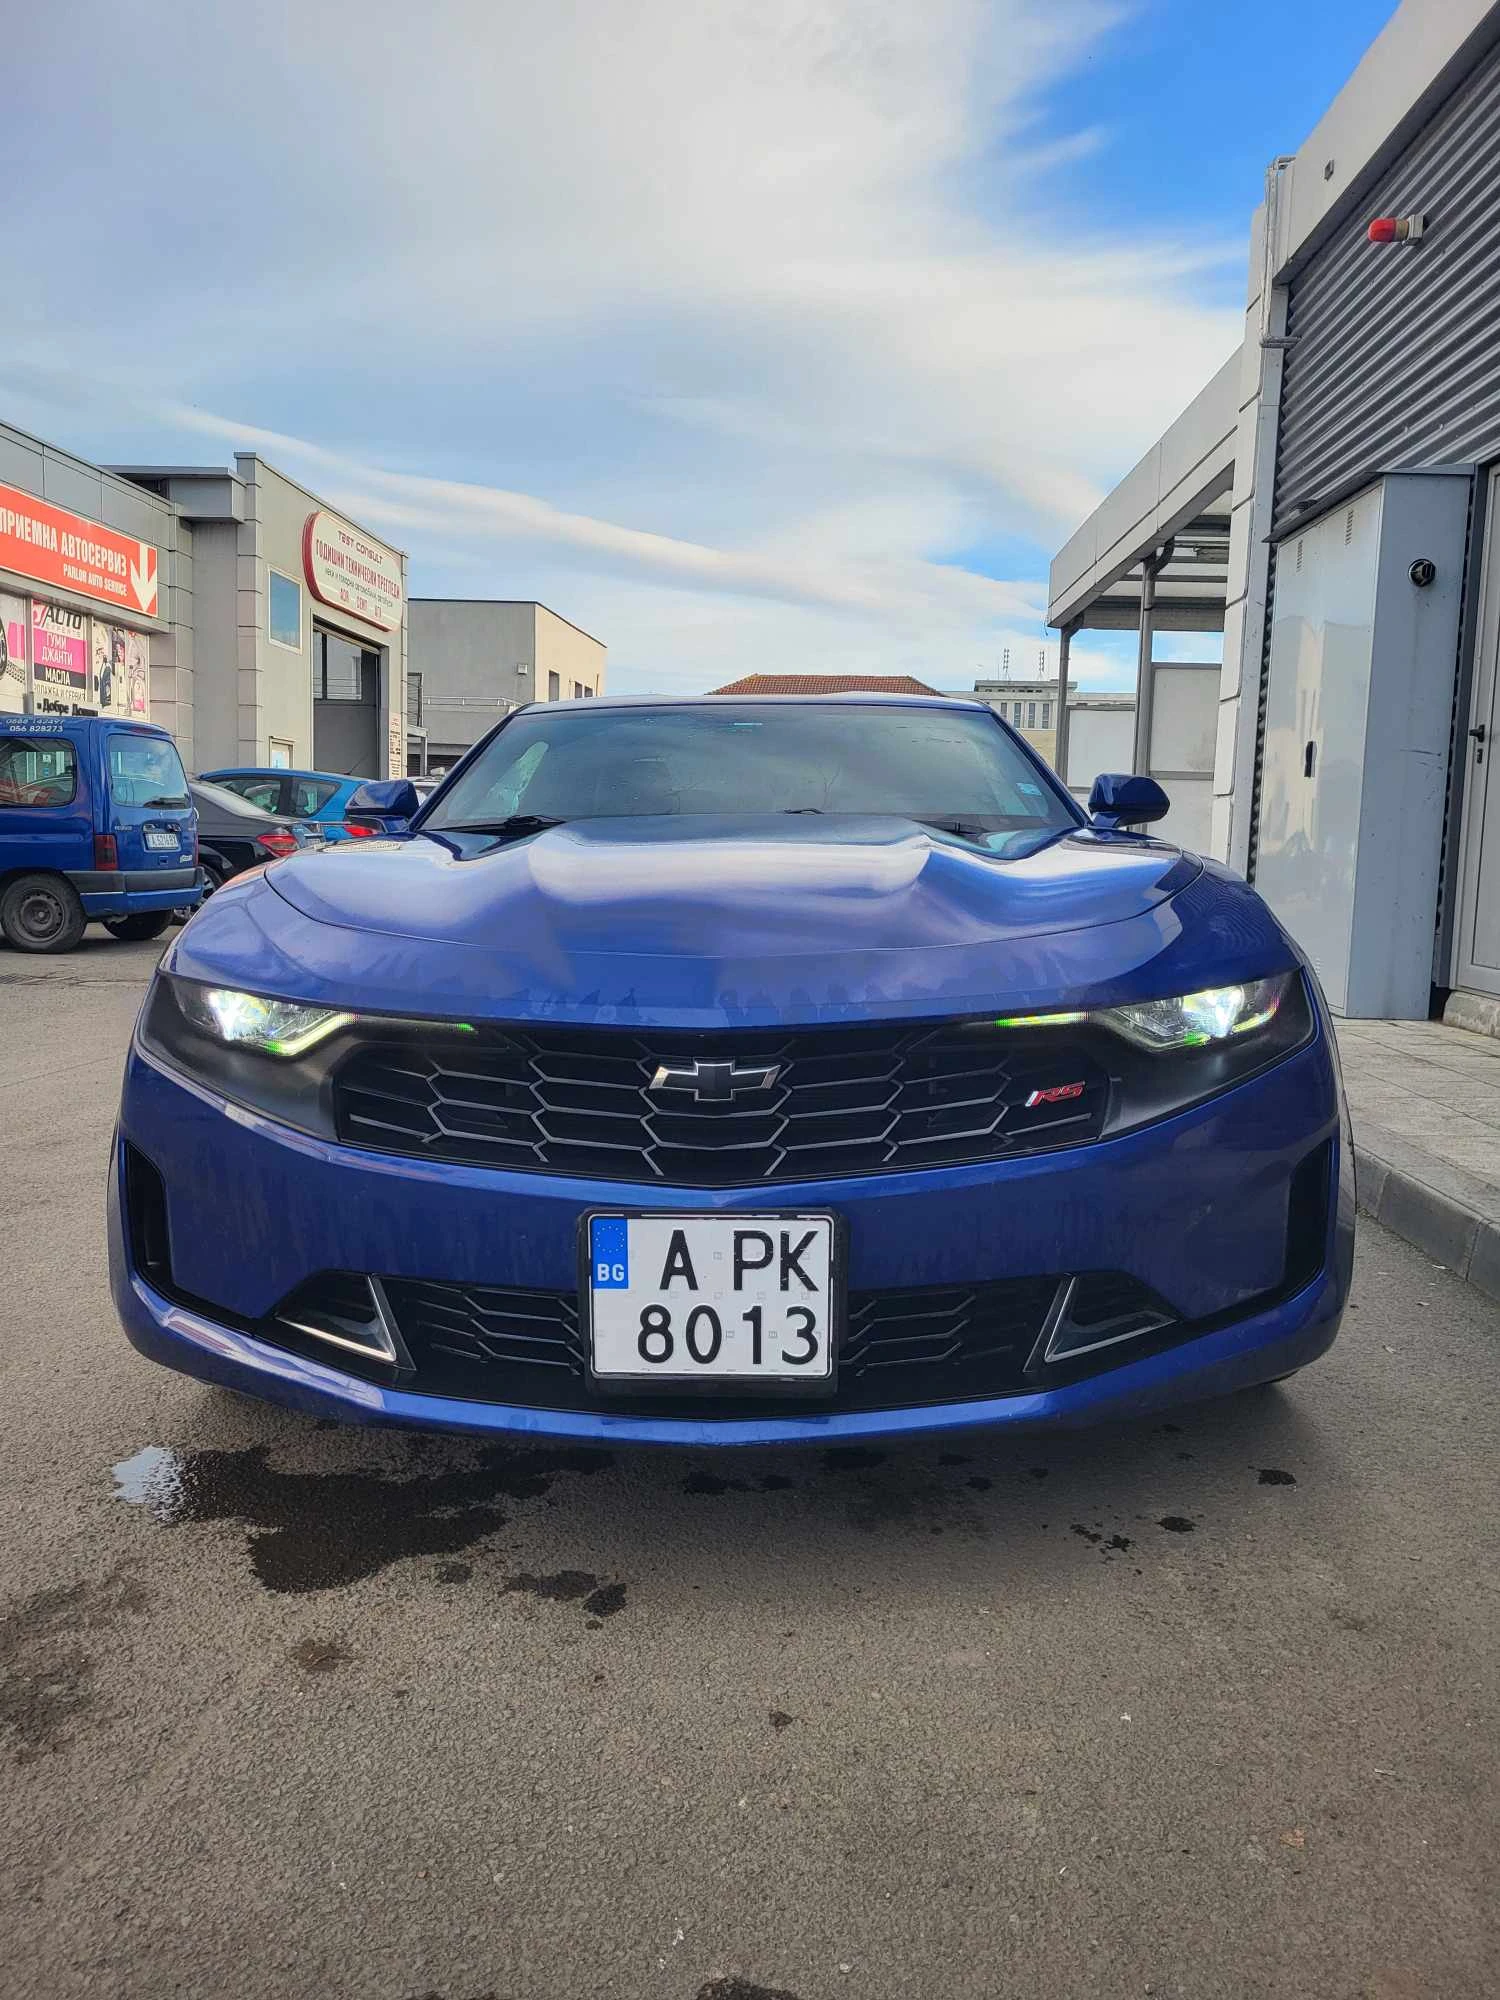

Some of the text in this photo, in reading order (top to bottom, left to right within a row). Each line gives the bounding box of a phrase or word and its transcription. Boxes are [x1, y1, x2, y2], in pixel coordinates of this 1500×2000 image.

[0, 507, 127, 577] ПРИЕМНА АВТОСЕРВИЗ
[338, 530, 354, 548] TEST
[63, 563, 128, 597] PARLOR AUTO SERVICE
[345, 555, 376, 587] ТЕХНИЧЕСКИ
[46, 633, 66, 650] ГУМИ
[42, 646, 73, 667] ДЖАНТИ
[45, 666, 71, 686] МАСЛА
[43, 698, 69, 716] Добре
[1025, 1081, 1085, 1107] RS
[659, 1229, 819, 1292] A PK
[597, 1263, 625, 1282] BG
[637, 1303, 819, 1365] 8013
